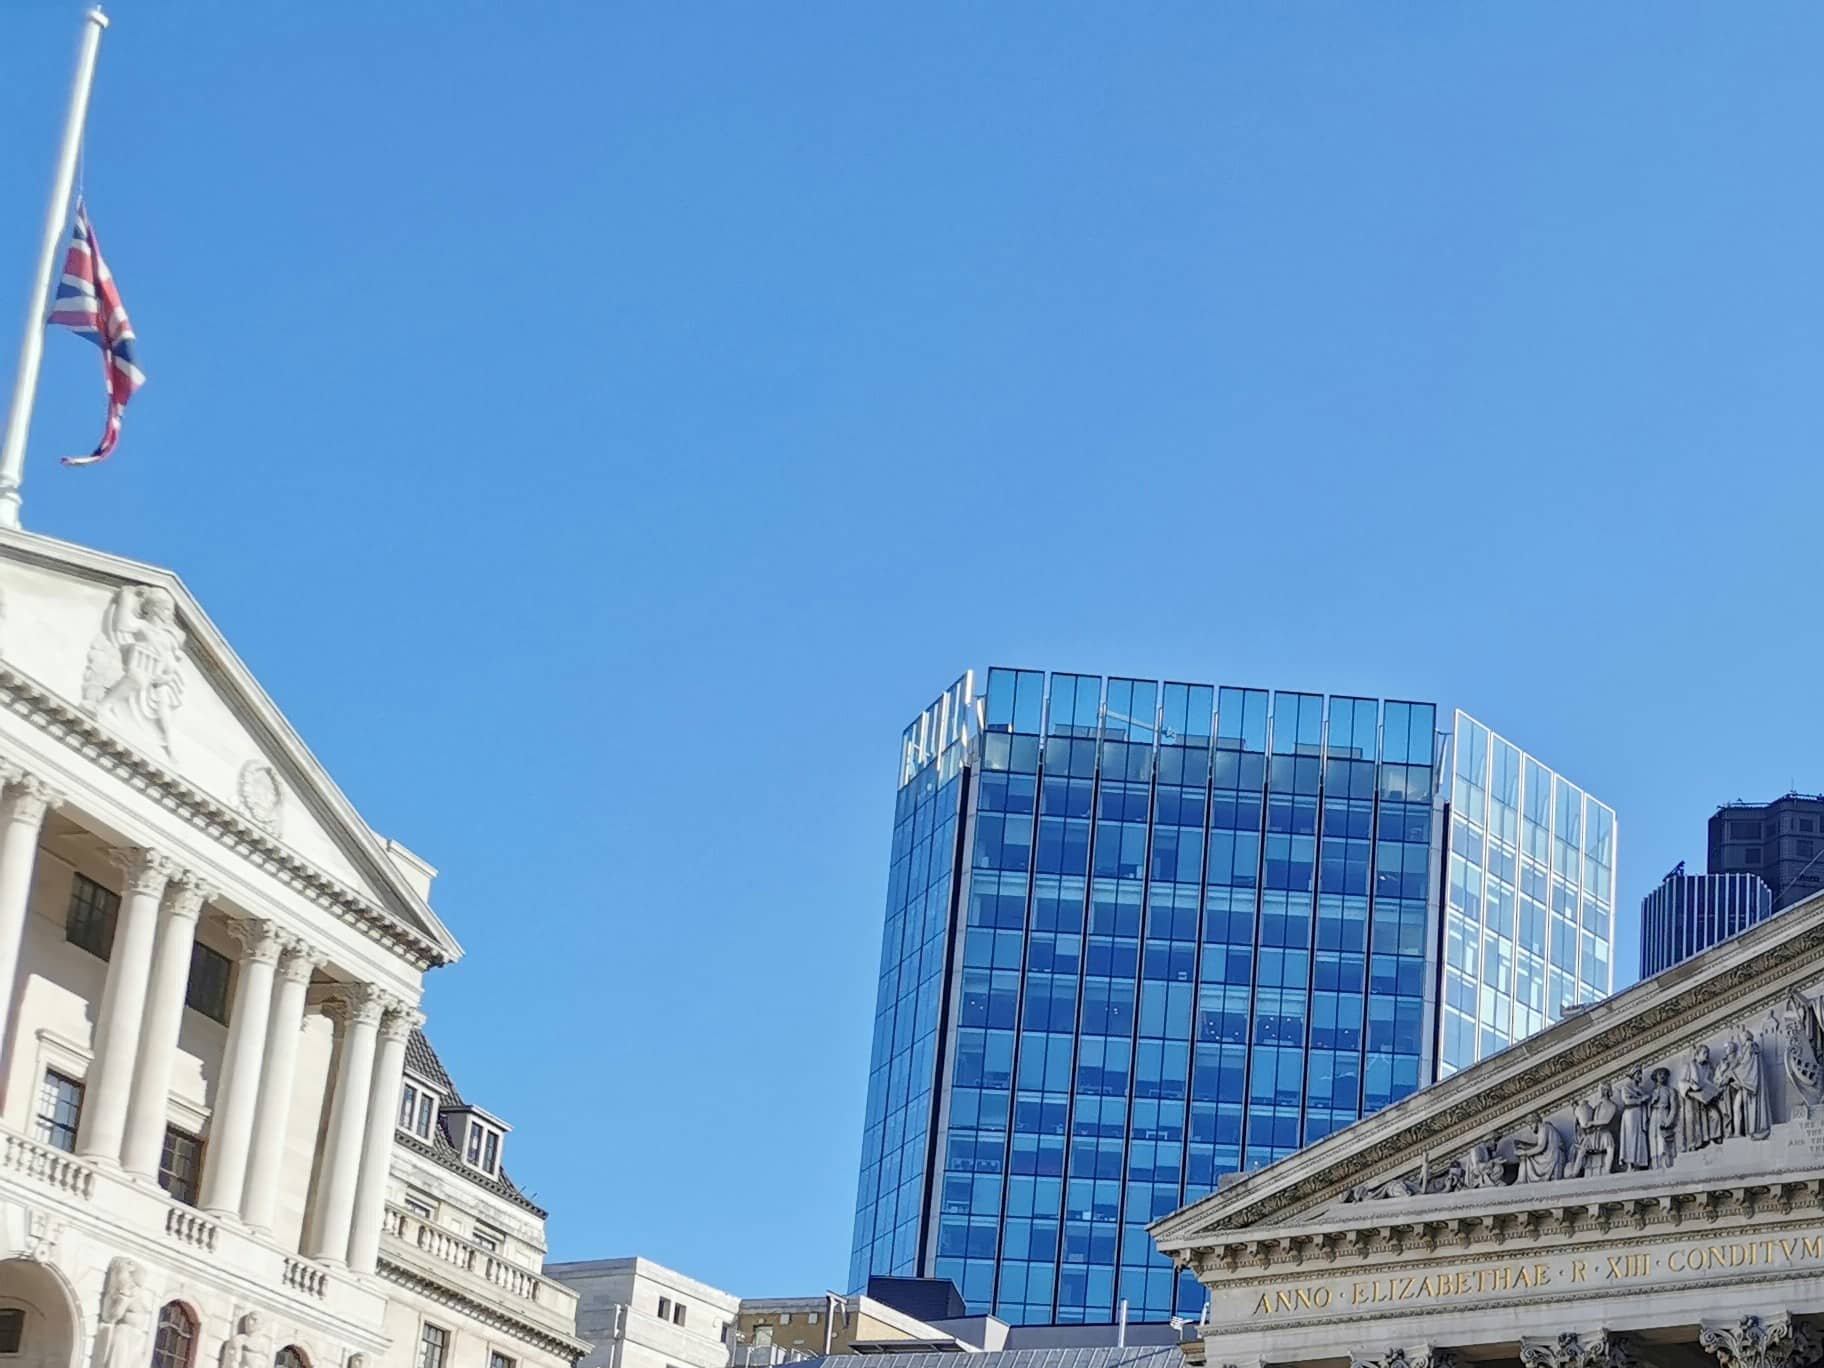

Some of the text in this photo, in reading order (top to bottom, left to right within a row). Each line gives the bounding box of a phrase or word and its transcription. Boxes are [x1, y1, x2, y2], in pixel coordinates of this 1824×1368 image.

[1253, 1286, 1333, 1315] ANNO
[1352, 1263, 1552, 1305] ELIZABETHAE
[1571, 1259, 1588, 1283] R
[1606, 1253, 1651, 1280] XIII
[1667, 1235, 1824, 1273] CONDITVM
